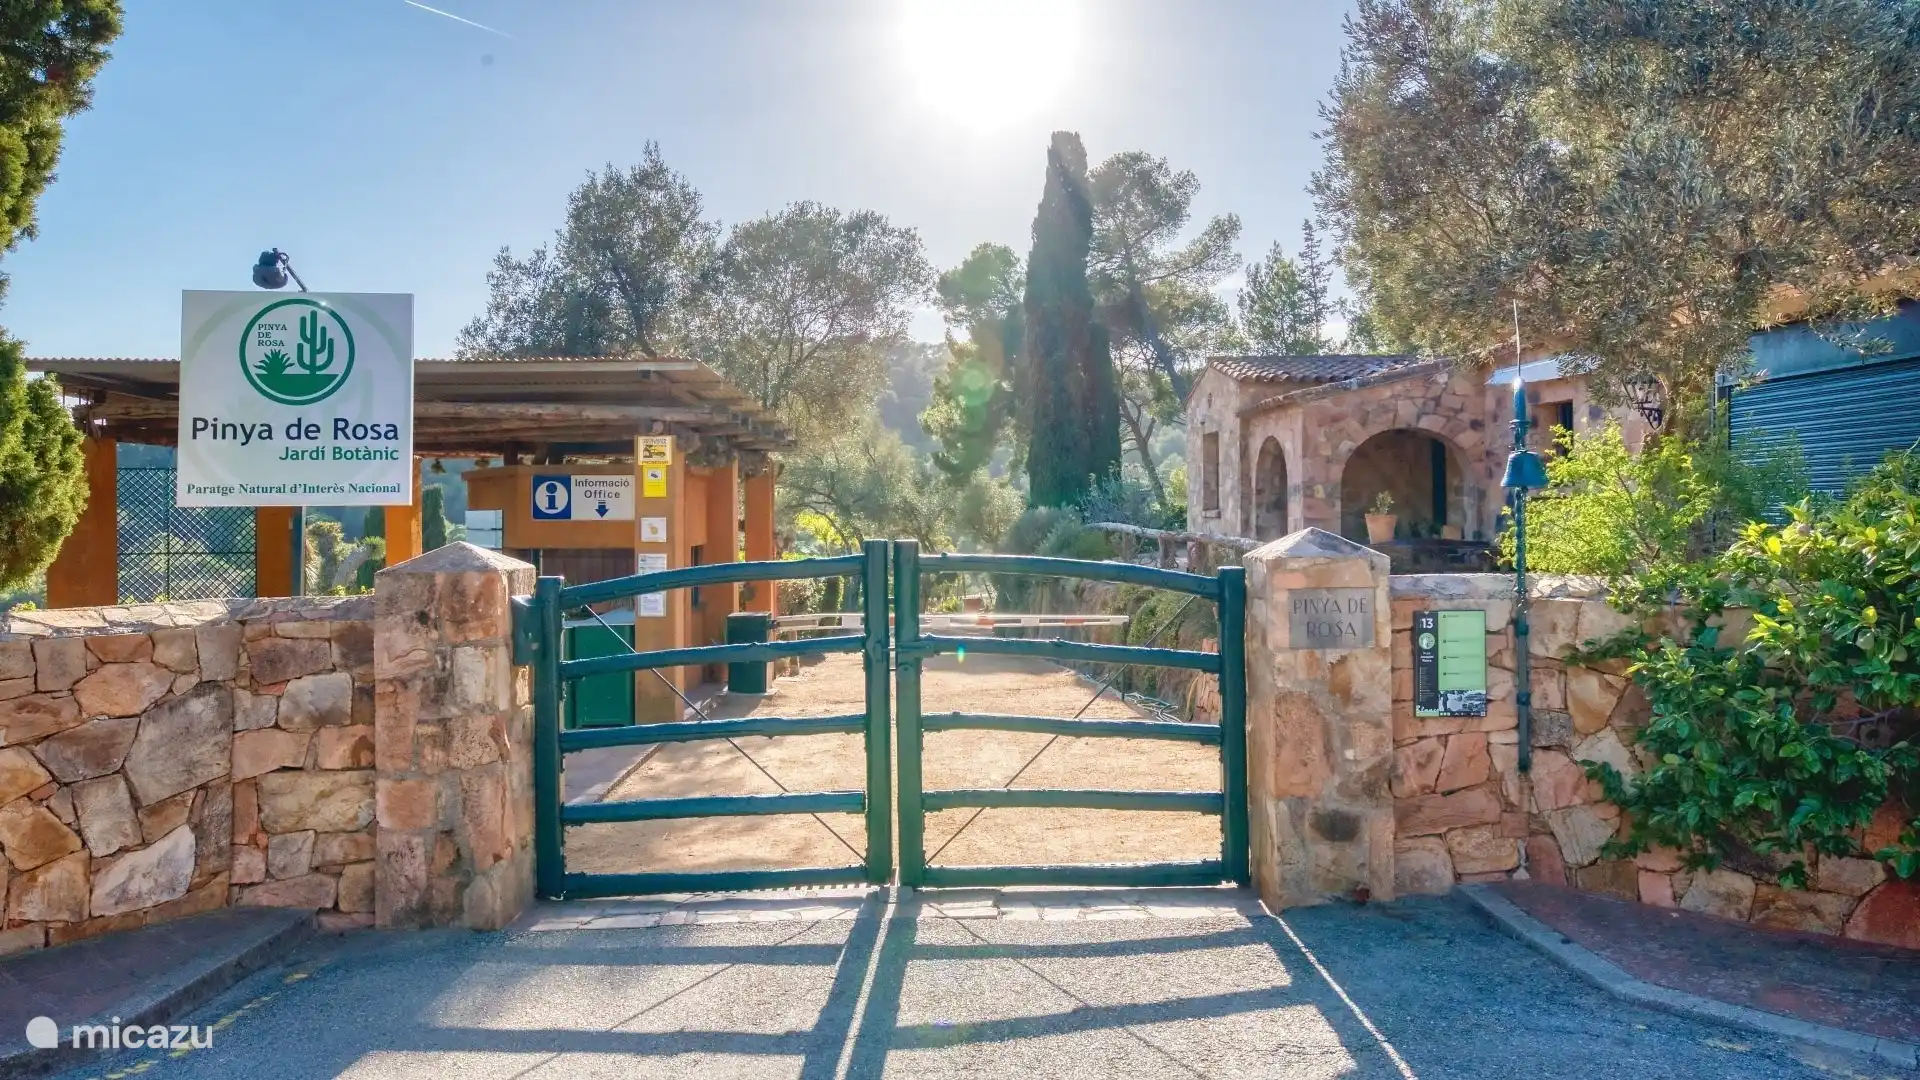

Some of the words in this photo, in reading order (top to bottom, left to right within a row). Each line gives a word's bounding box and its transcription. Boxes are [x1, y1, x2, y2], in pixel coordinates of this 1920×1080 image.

[257, 323, 288, 331] PINYA
[257, 331, 272, 339] DE
[257, 339, 285, 347] ROSA
[191, 417, 273, 446] Pinya
[285, 416, 321, 441] de
[333, 417, 399, 441] Rosa
[279, 446, 326, 461] Jardí
[332, 446, 400, 461] Botànic
[574, 478, 630, 488] Informació
[187, 484, 235, 496] Paratge
[239, 484, 286, 494] Natural
[348, 483, 401, 494] Nacional
[584, 490, 621, 499] Office
[1294, 599, 1342, 614] PINYA
[1349, 598, 1368, 613] DE
[1421, 617, 1434, 629] 13
[1307, 621, 1357, 638] ROSA
